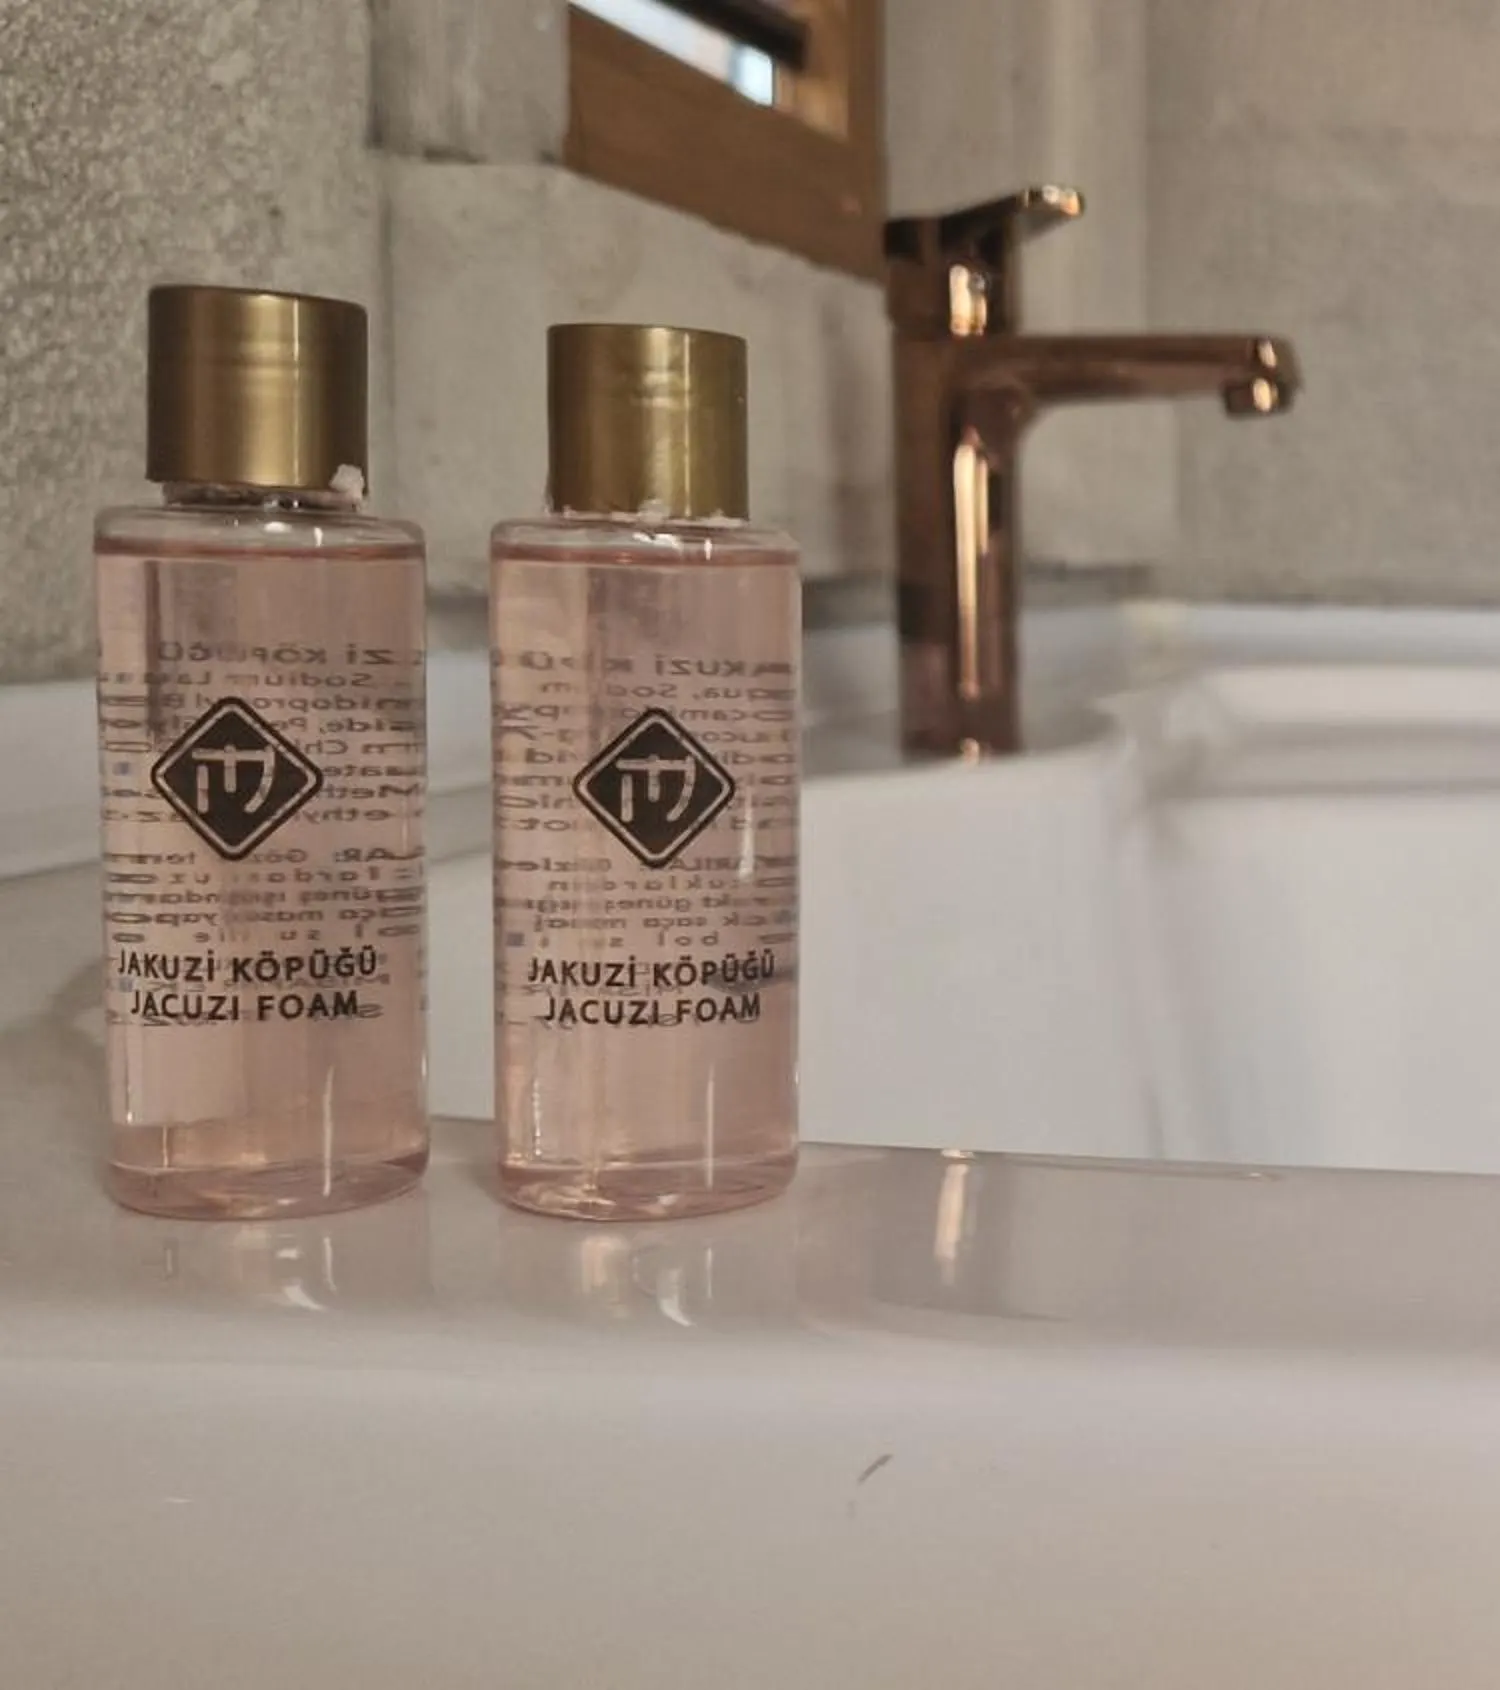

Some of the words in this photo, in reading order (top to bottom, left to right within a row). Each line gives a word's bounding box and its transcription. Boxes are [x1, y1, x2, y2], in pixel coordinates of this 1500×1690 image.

[118, 949, 215, 982] JAKUZİ
[231, 945, 378, 984] KÖPÜĞÜ
[527, 955, 636, 988] JAKUZİ
[652, 948, 776, 988] KÖPÜĞÜ
[129, 990, 240, 1021] JACUZI
[256, 991, 359, 1021] FOAM
[544, 997, 660, 1026] JACUZI
[676, 993, 761, 1024] FOAM
